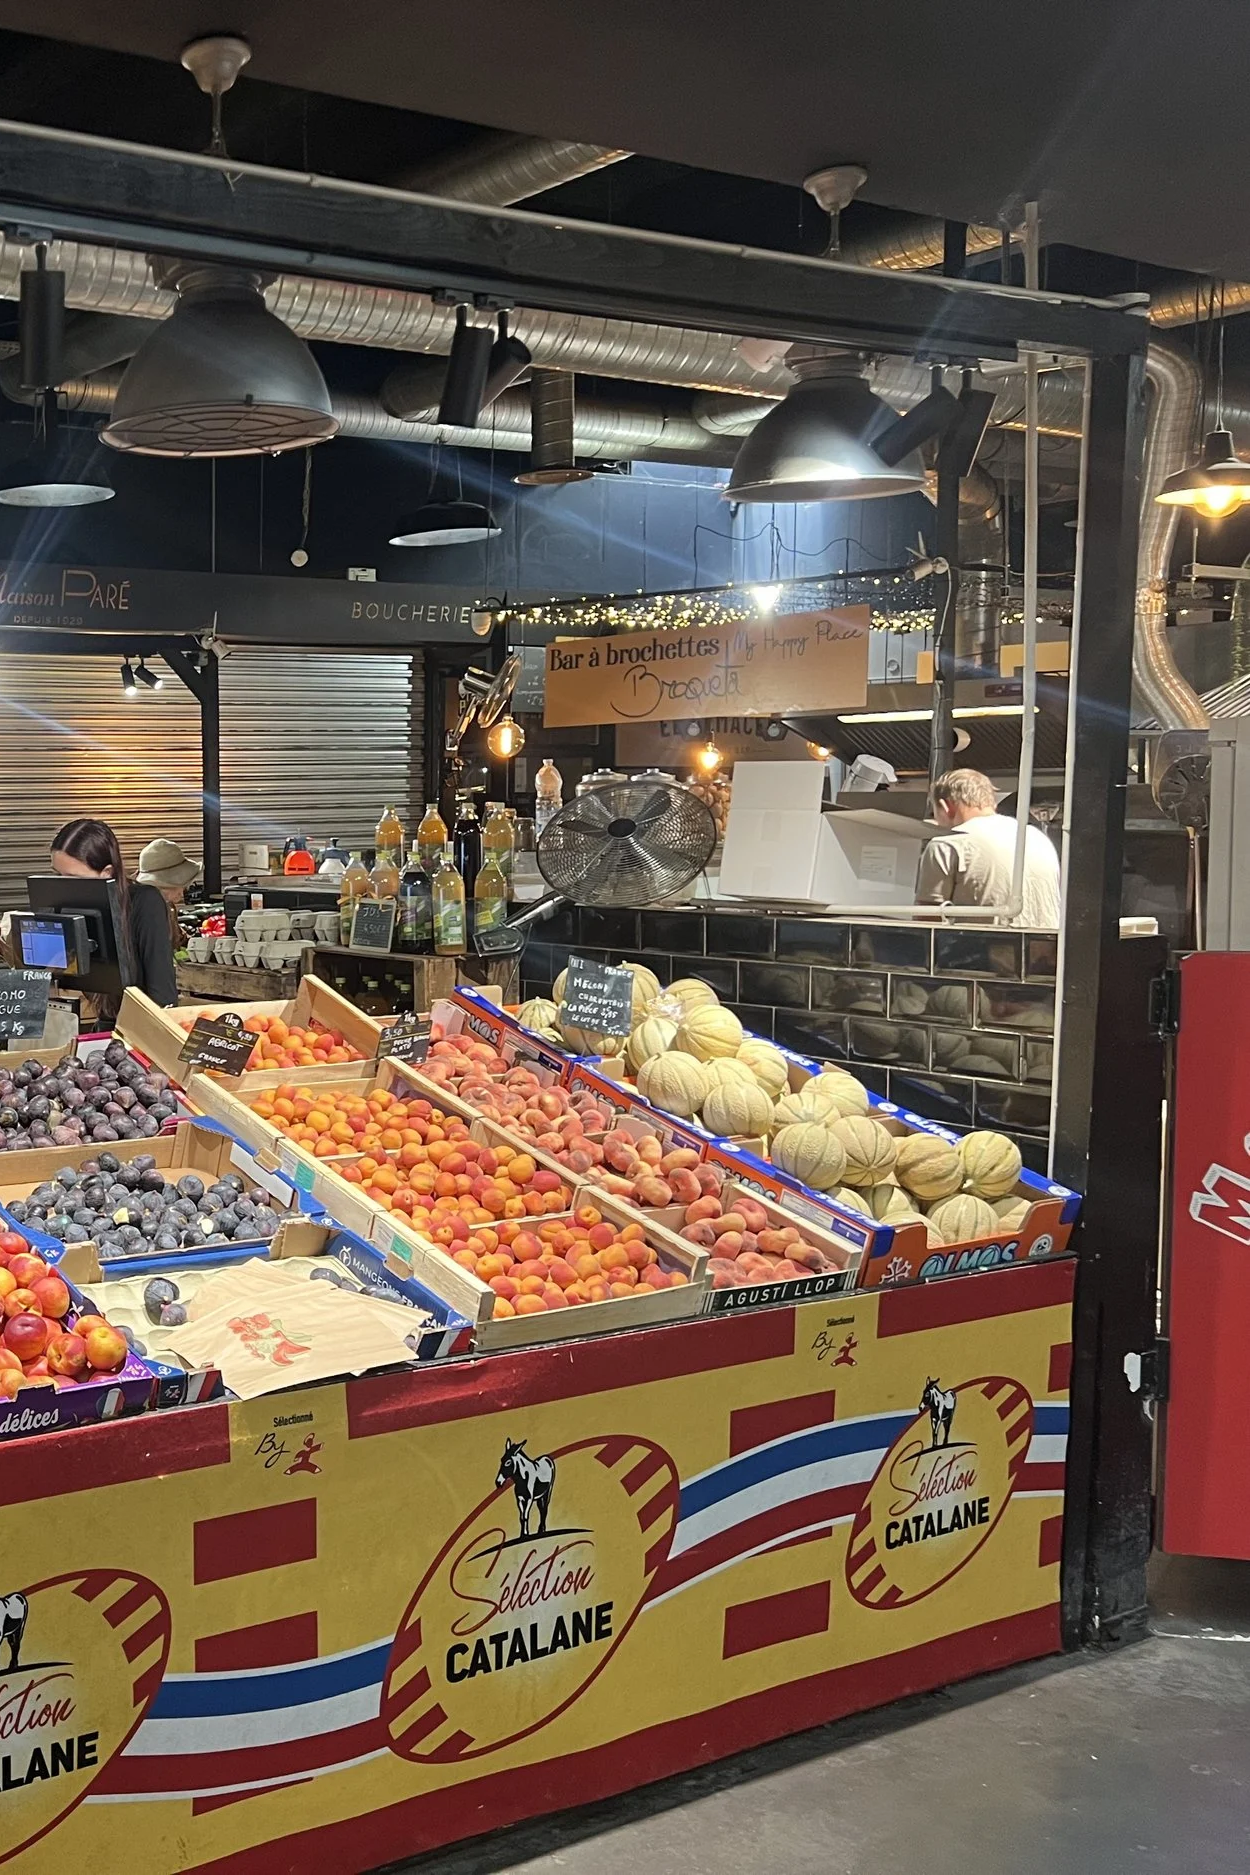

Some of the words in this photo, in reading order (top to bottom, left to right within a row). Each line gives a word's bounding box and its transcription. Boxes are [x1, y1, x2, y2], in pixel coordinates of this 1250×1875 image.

[13, 615, 51, 624] DEPUIS
[351, 601, 472, 624] BOUCHERIE
[549, 647, 584, 671] Bar
[589, 649, 600, 668] à
[605, 636, 720, 665] brochettes
[763, 629, 810, 660] Happy
[815, 619, 864, 646] Place
[225, 1014, 240, 1027] 1kg
[469, 1014, 500, 1045] MOS
[724, 1283, 789, 1307] AGUSTÍ
[794, 1278, 835, 1296] LLOP
[811, 1331, 837, 1361] By
[273, 1411, 313, 1428] Sélectionné
[254, 1432, 291, 1468] By
[889, 1439, 978, 1517] Sélection
[885, 1496, 990, 1551] CATALANE
[450, 1527, 595, 1637] Sélection
[446, 1601, 614, 1684] CATALANE
